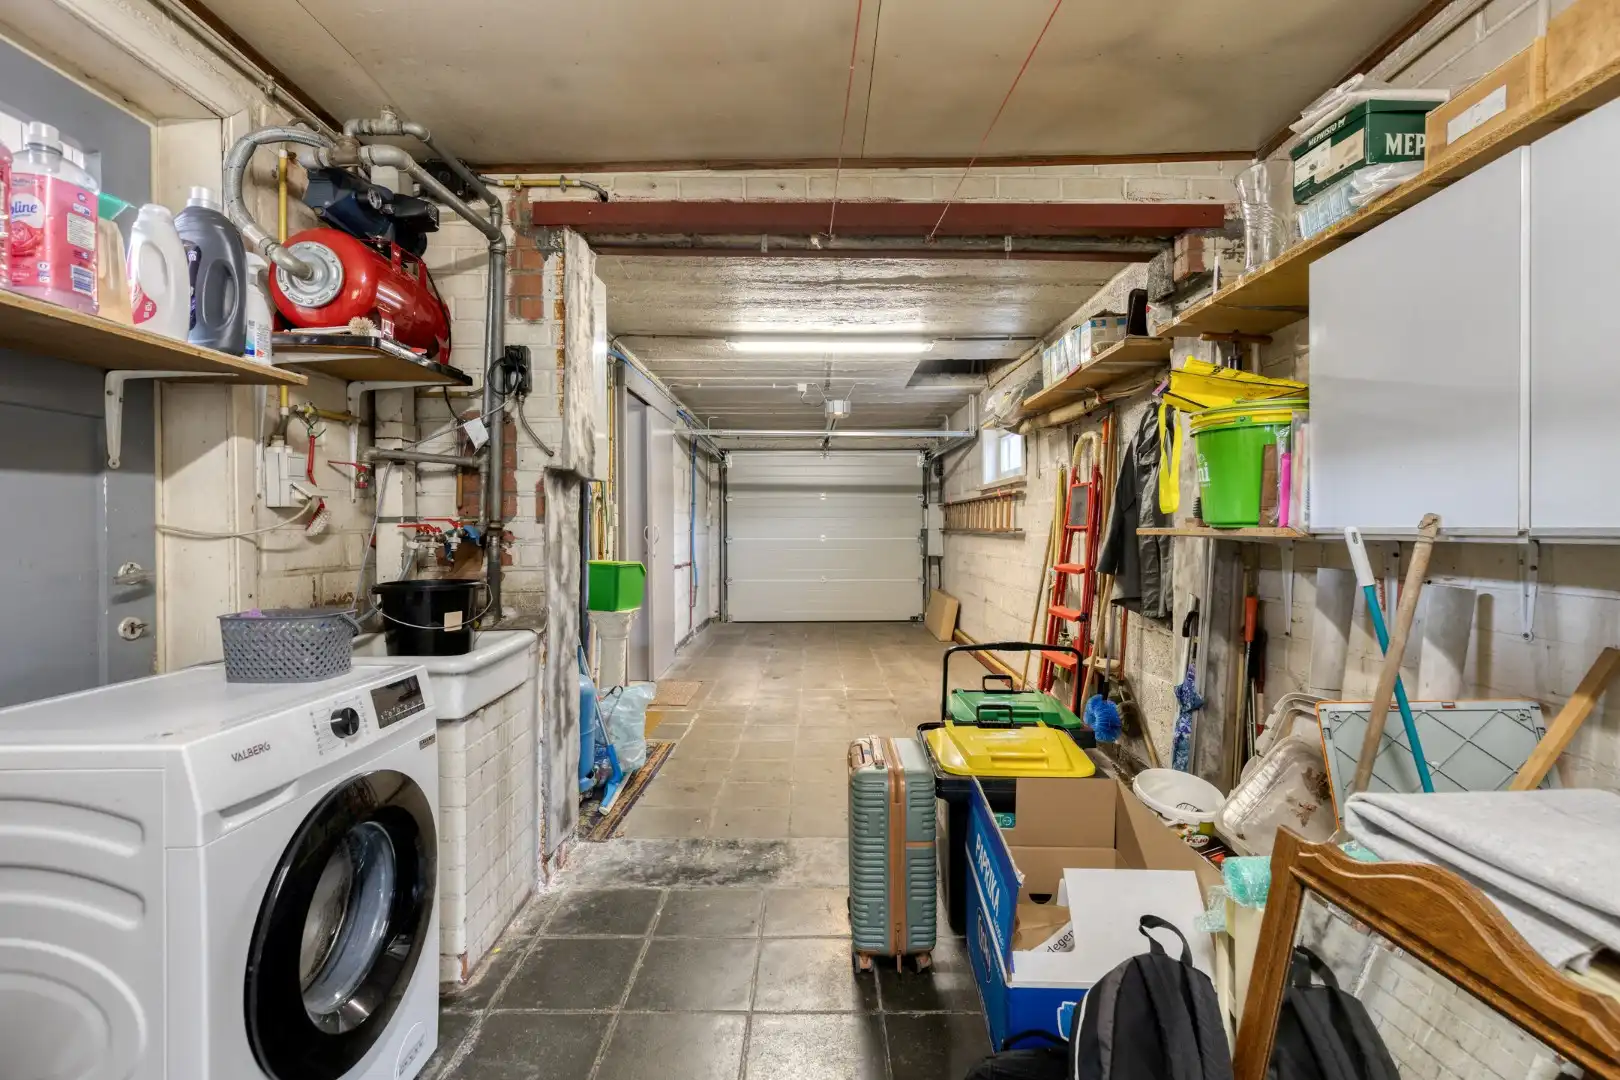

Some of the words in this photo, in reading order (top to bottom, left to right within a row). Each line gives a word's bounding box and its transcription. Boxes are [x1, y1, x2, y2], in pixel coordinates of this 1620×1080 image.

[1308, 123, 1337, 147] MEPHISTO
[1385, 133, 1425, 156] MEP
[231, 741, 271, 762] VALBERG
[975, 832, 1000, 917] PAPRIKA
